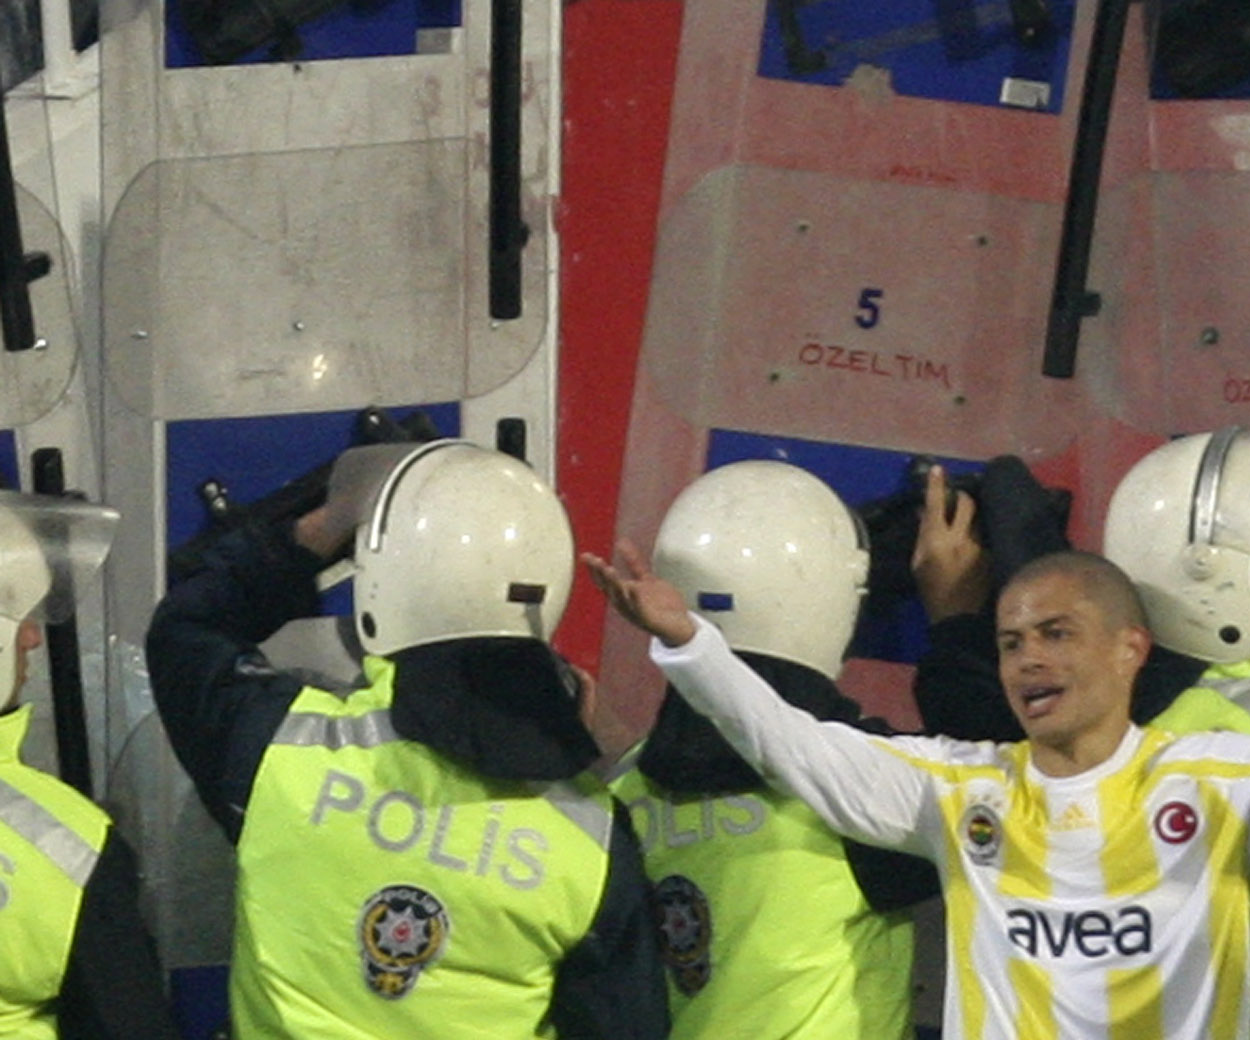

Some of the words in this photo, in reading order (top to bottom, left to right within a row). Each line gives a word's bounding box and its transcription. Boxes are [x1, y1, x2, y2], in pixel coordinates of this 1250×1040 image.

[854, 288, 884, 330] 5
[309, 768, 553, 891] POLİS
[1007, 905, 1153, 958] avea
